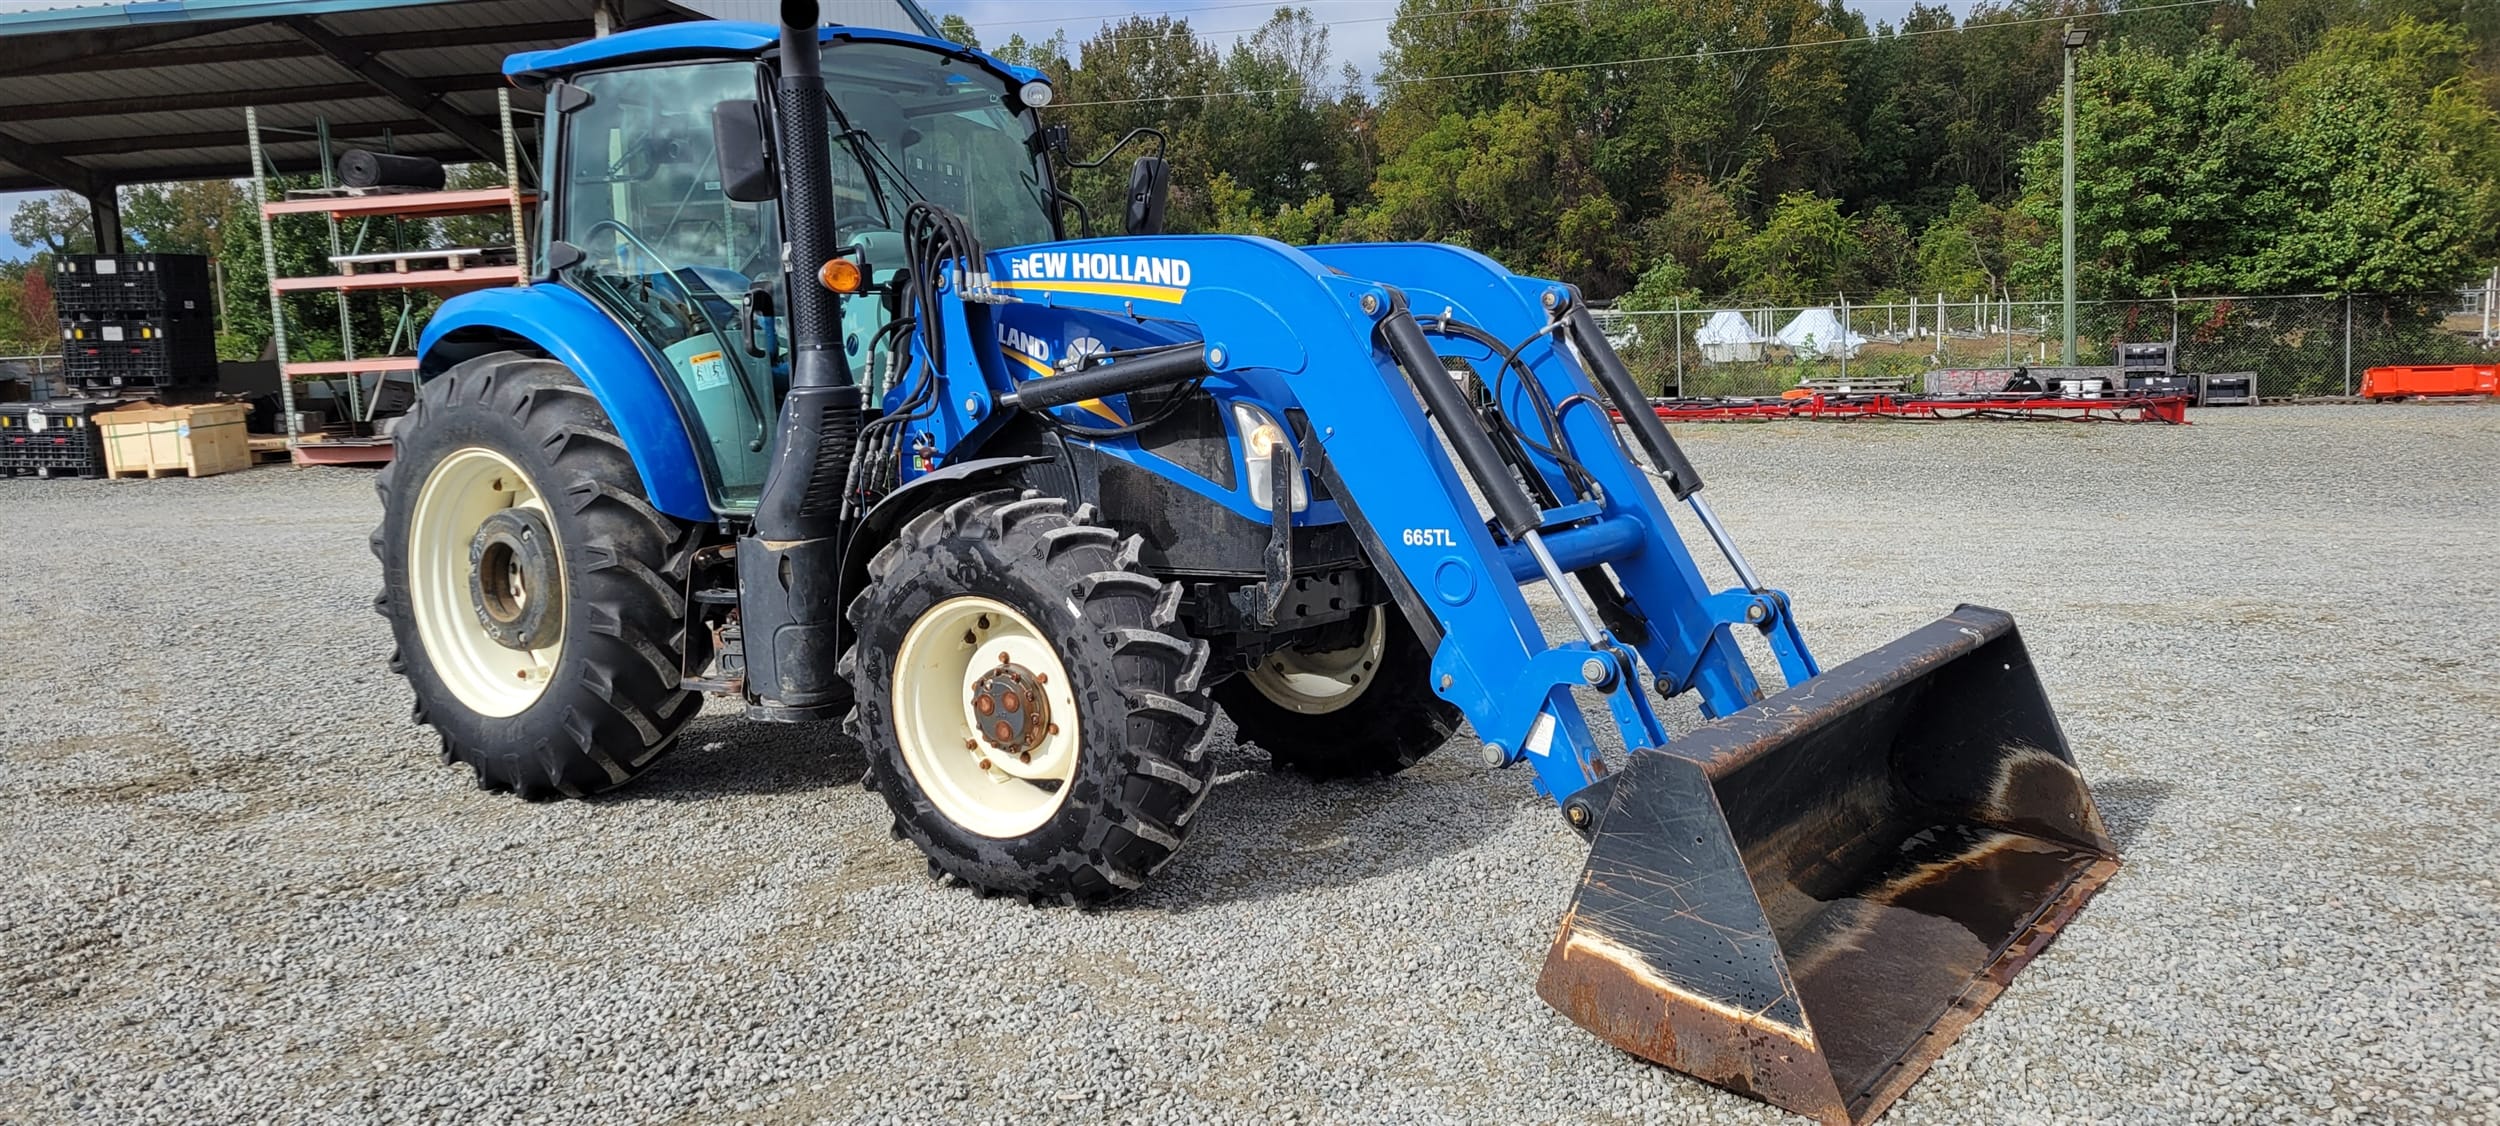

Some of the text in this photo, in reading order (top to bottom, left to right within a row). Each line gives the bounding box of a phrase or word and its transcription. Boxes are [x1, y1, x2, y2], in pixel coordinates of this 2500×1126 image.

[1012, 252, 1191, 286] NEW HOLLAND
[1403, 528, 1457, 547] 665TL
